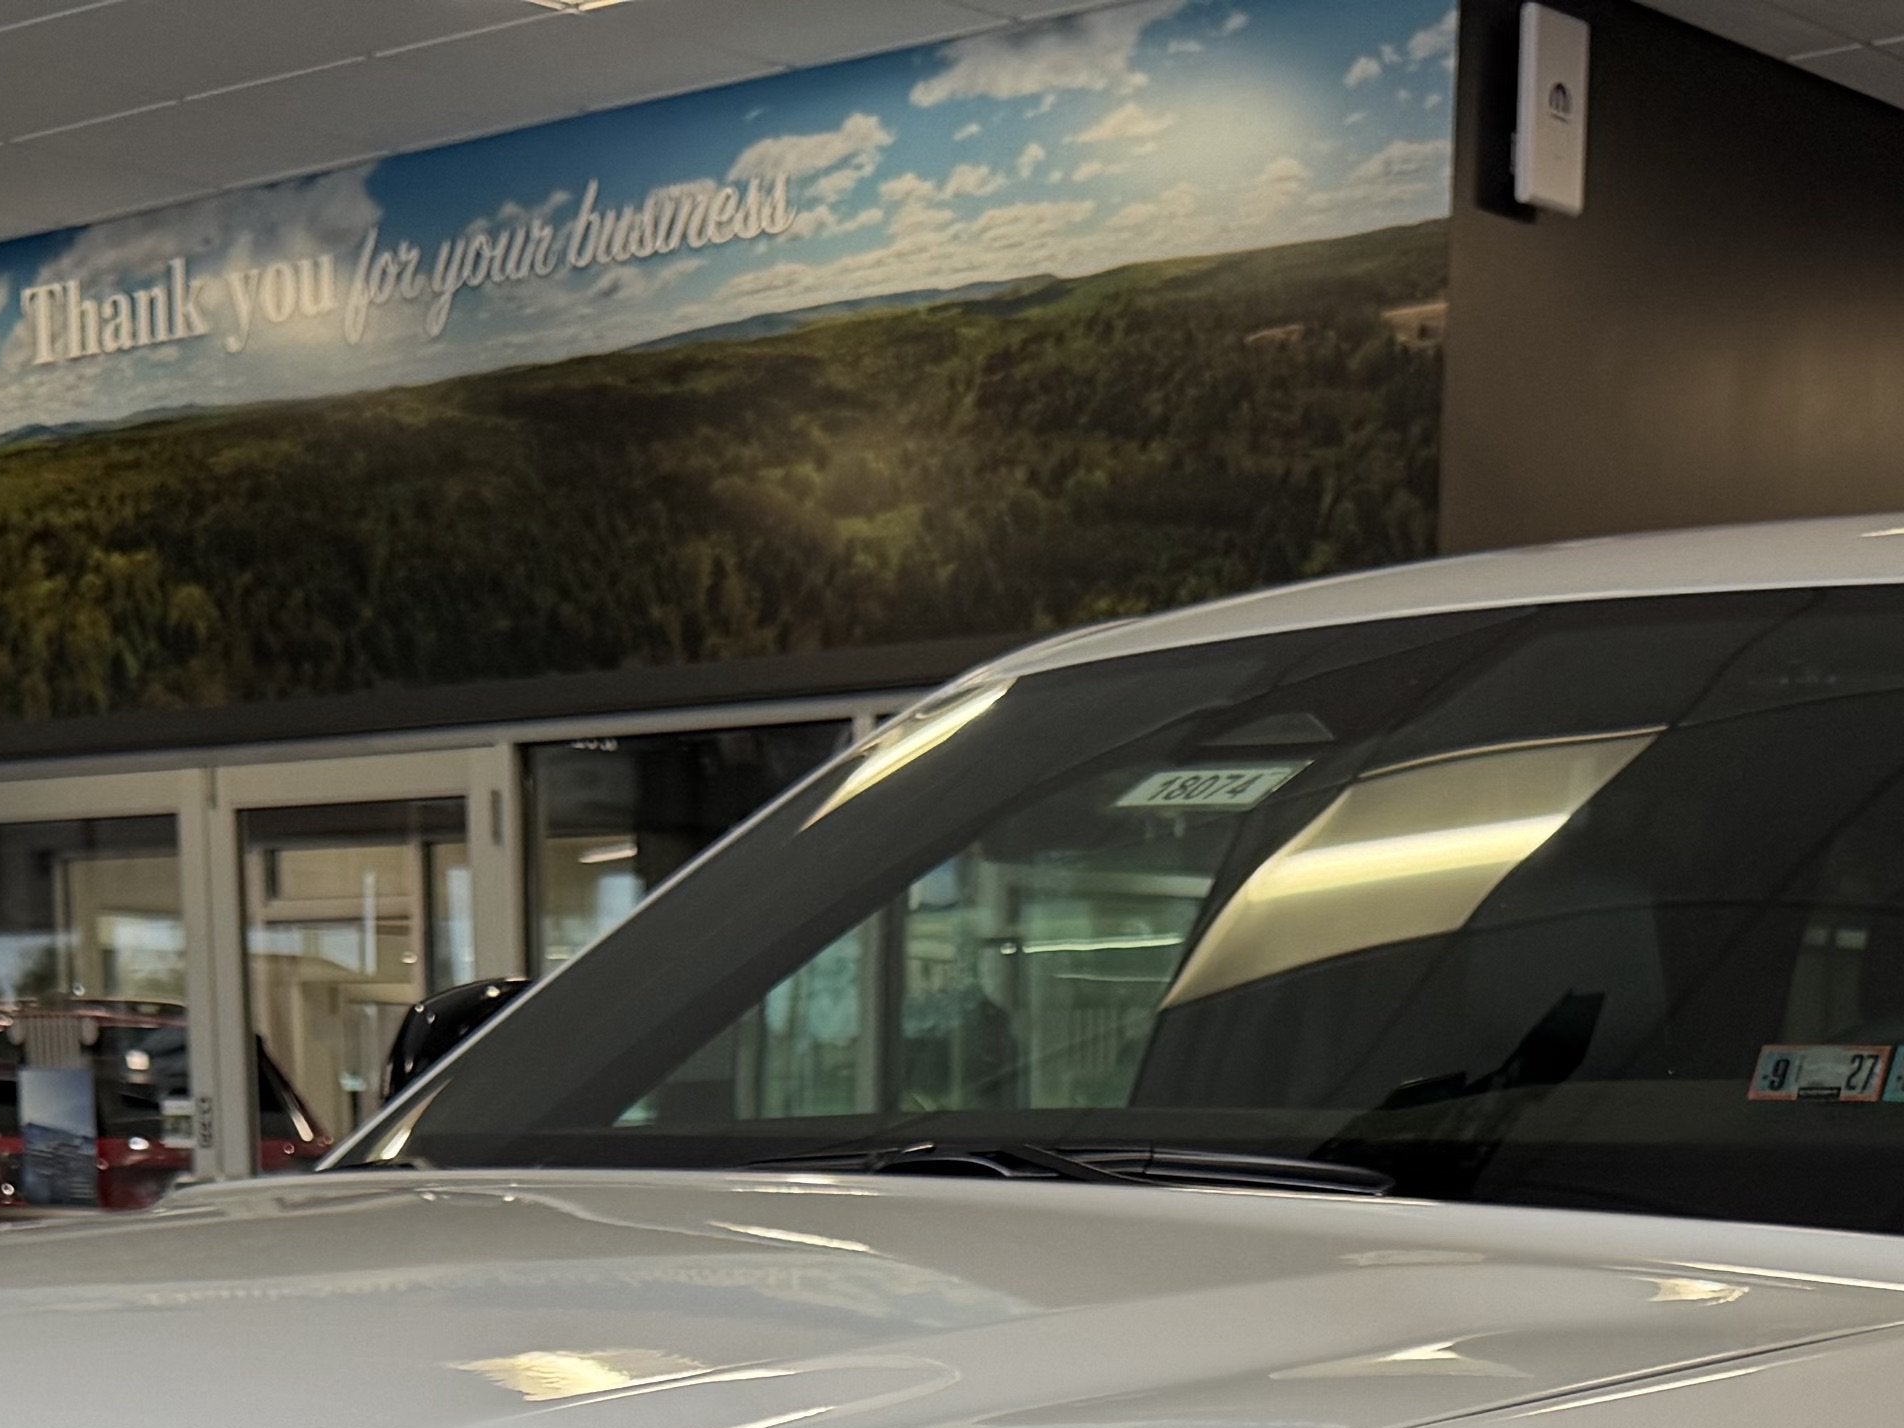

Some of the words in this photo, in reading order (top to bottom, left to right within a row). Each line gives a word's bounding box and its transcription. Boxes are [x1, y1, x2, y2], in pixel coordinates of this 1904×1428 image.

[21, 257, 209, 366] Thank
[224, 253, 336, 353] you
[344, 226, 424, 345] for
[422, 218, 558, 337] your
[567, 171, 798, 268] business
[1147, 773, 1264, 801] 18074
[1846, 1054, 1880, 1095] 27
